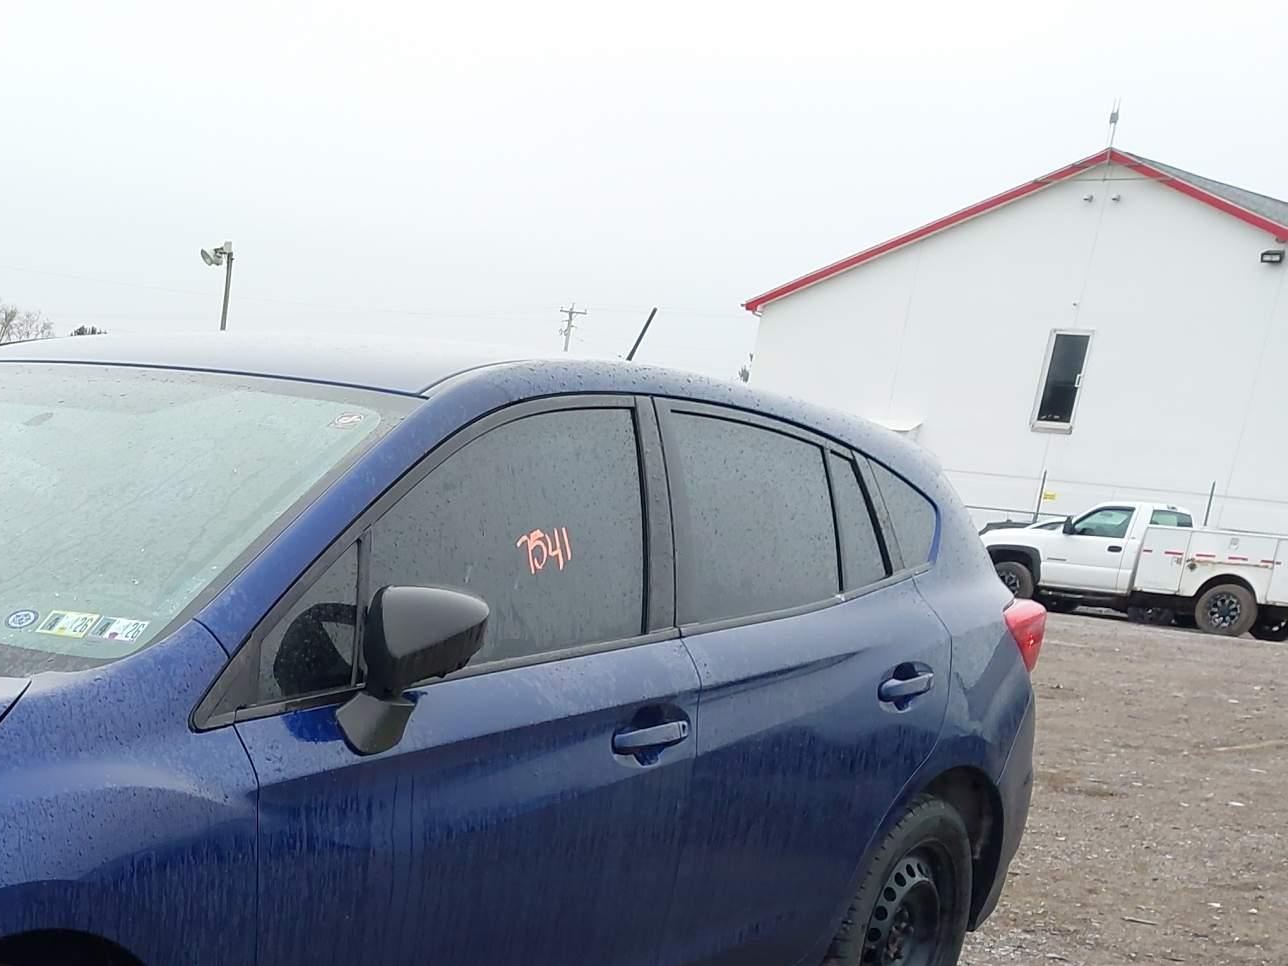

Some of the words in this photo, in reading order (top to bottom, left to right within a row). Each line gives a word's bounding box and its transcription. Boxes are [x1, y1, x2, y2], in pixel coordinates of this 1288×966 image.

[516, 527, 572, 574] 7541
[73, 616, 93, 634] 26
[124, 622, 146, 639] 26
